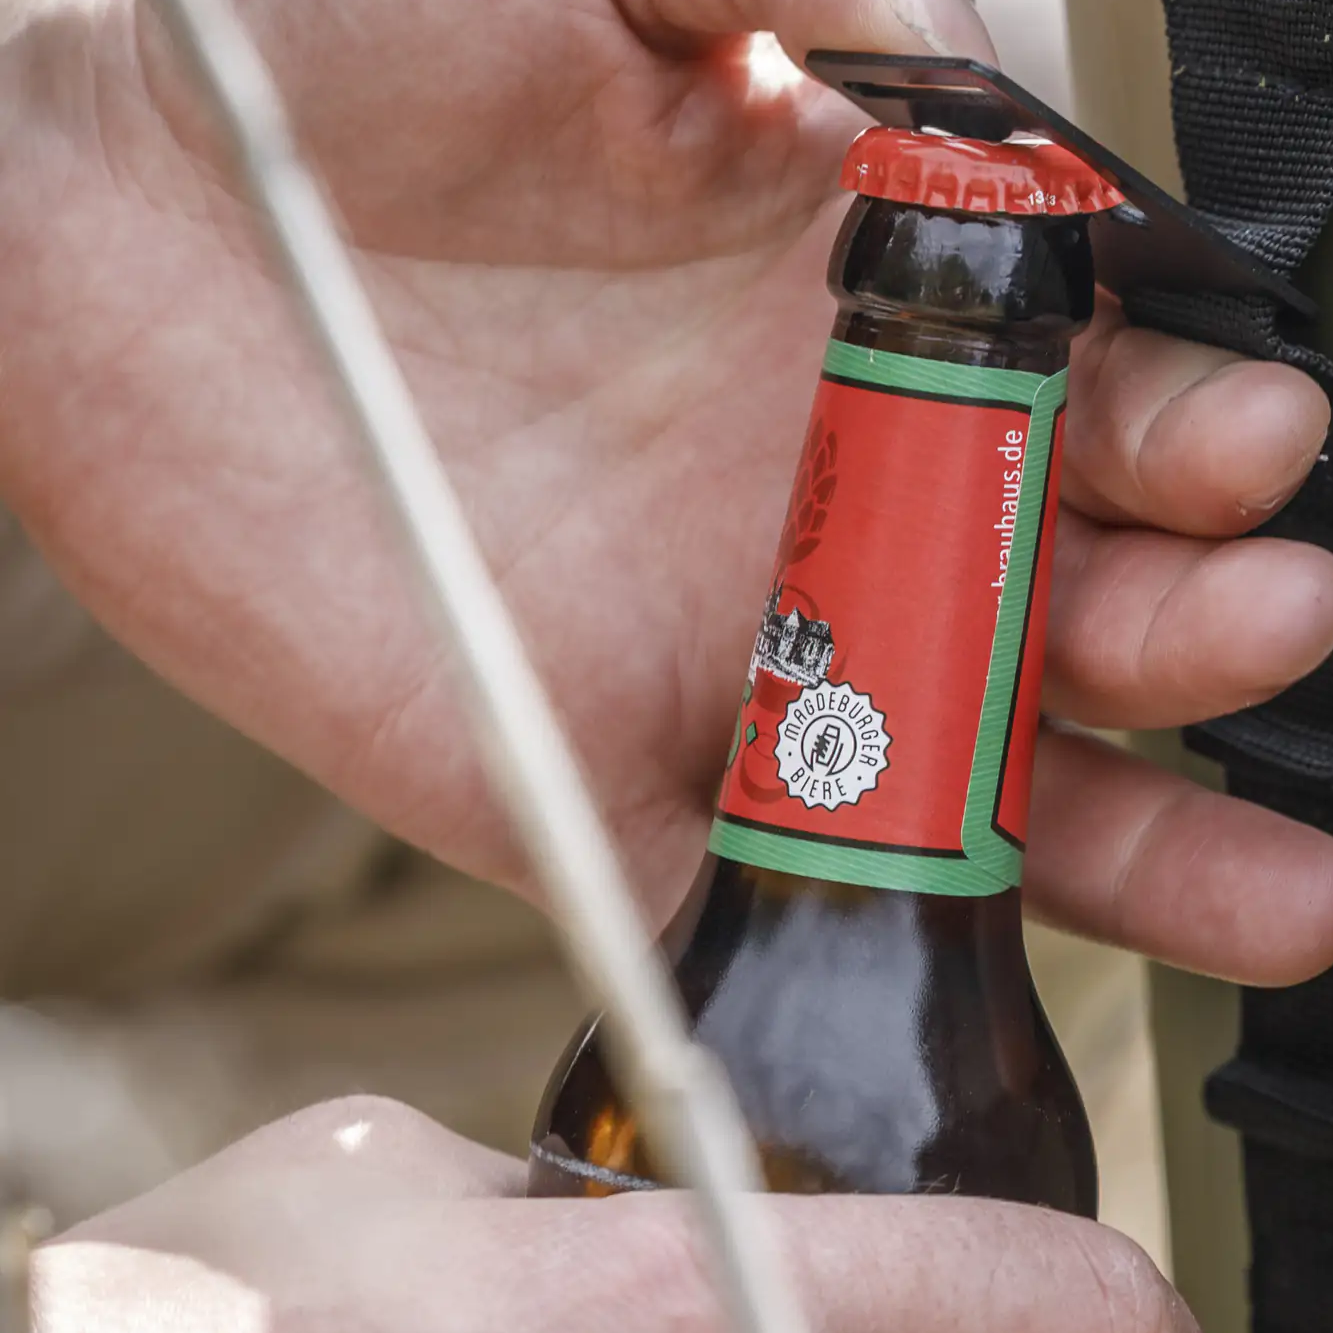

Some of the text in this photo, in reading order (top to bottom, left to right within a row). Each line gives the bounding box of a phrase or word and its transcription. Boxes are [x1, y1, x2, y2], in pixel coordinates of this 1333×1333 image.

[990, 429, 1024, 605] brauhaus.de
[784, 691, 881, 768] MAGDEBURGER
[790, 766, 847, 800] BIERE
